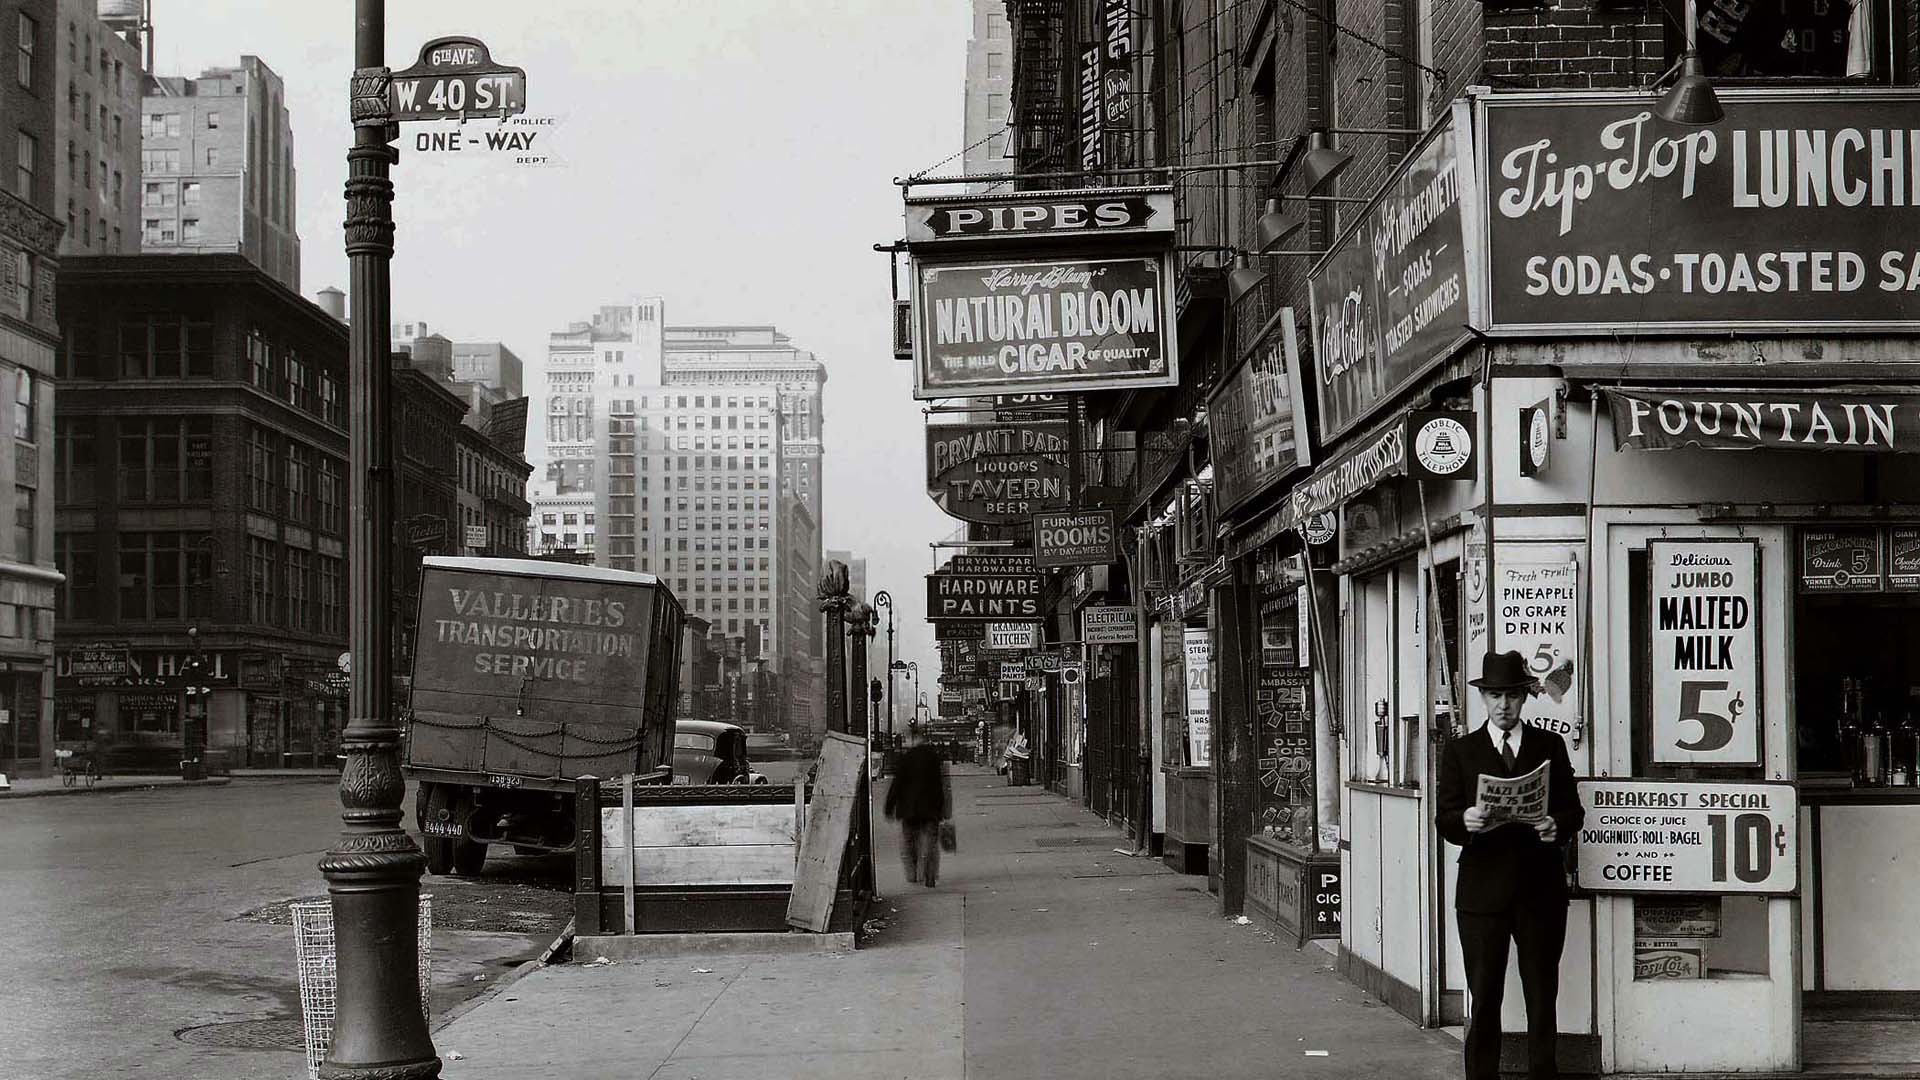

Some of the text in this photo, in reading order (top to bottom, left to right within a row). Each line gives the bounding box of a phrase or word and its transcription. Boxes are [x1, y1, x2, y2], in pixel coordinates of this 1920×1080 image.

[433, 48, 478, 66] 6TH AVE.
[394, 76, 516, 112] W. 40 ST.
[1499, 111, 1718, 236] Tip-Top
[945, 202, 1131, 233] PIPES
[1403, 248, 1432, 297] SODAS
[1675, 251, 1866, 293] TOASTED
[936, 288, 1155, 345] NATURAL BLOOM
[1385, 273, 1460, 356] TOASTED SANDWICHES
[942, 356, 965, 369] THE
[998, 342, 1087, 373] CIGAR
[1087, 350, 1101, 361] OF
[1103, 347, 1149, 361] QUALITY
[1425, 420, 1462, 432] PUBLIC
[1628, 400, 1899, 448] FOUNTAIN
[935, 429, 1016, 477] BRYANT
[1419, 450, 1468, 472] TELEPHONE
[975, 461, 1038, 472] LIQUORS
[950, 478, 1060, 499] TAVERN
[986, 503, 1030, 514] BEER
[1042, 516, 1106, 528] FURNISHED
[1040, 526, 1111, 547] ROOMS
[1044, 548, 1057, 556] BY
[1060, 547, 1075, 555] DAY
[1670, 553, 1733, 567] Delicious
[1506, 566, 1569, 582] Fresh Fruit
[1671, 572, 1733, 589] JUMBO
[939, 579, 1039, 595] HARDWARE
[1504, 588, 1574, 600] PINEAPPLE
[449, 588, 625, 628] VALLERIE'S
[943, 599, 1037, 615] PAINTS
[1502, 606, 1567, 618] OR GRAPE
[1659, 595, 1748, 631] MALTED
[1087, 612, 1136, 623] ELECTRICIAN
[1505, 622, 1565, 635] DRINK
[435, 619, 633, 657] TRANSPORTATION
[992, 633, 1031, 646] KITCHEN
[1674, 636, 1734, 671] MILK
[474, 652, 587, 681] SERVICE
[1273, 738, 1307, 746] OLD
[1487, 785, 1513, 795] NAZI
[1506, 796, 1519, 805] 75
[1594, 791, 1770, 809] BREAKFAST SPECIAL
[1600, 815, 1687, 826] CHOICE OF JUICE
[1602, 864, 1672, 882] COFFEE
